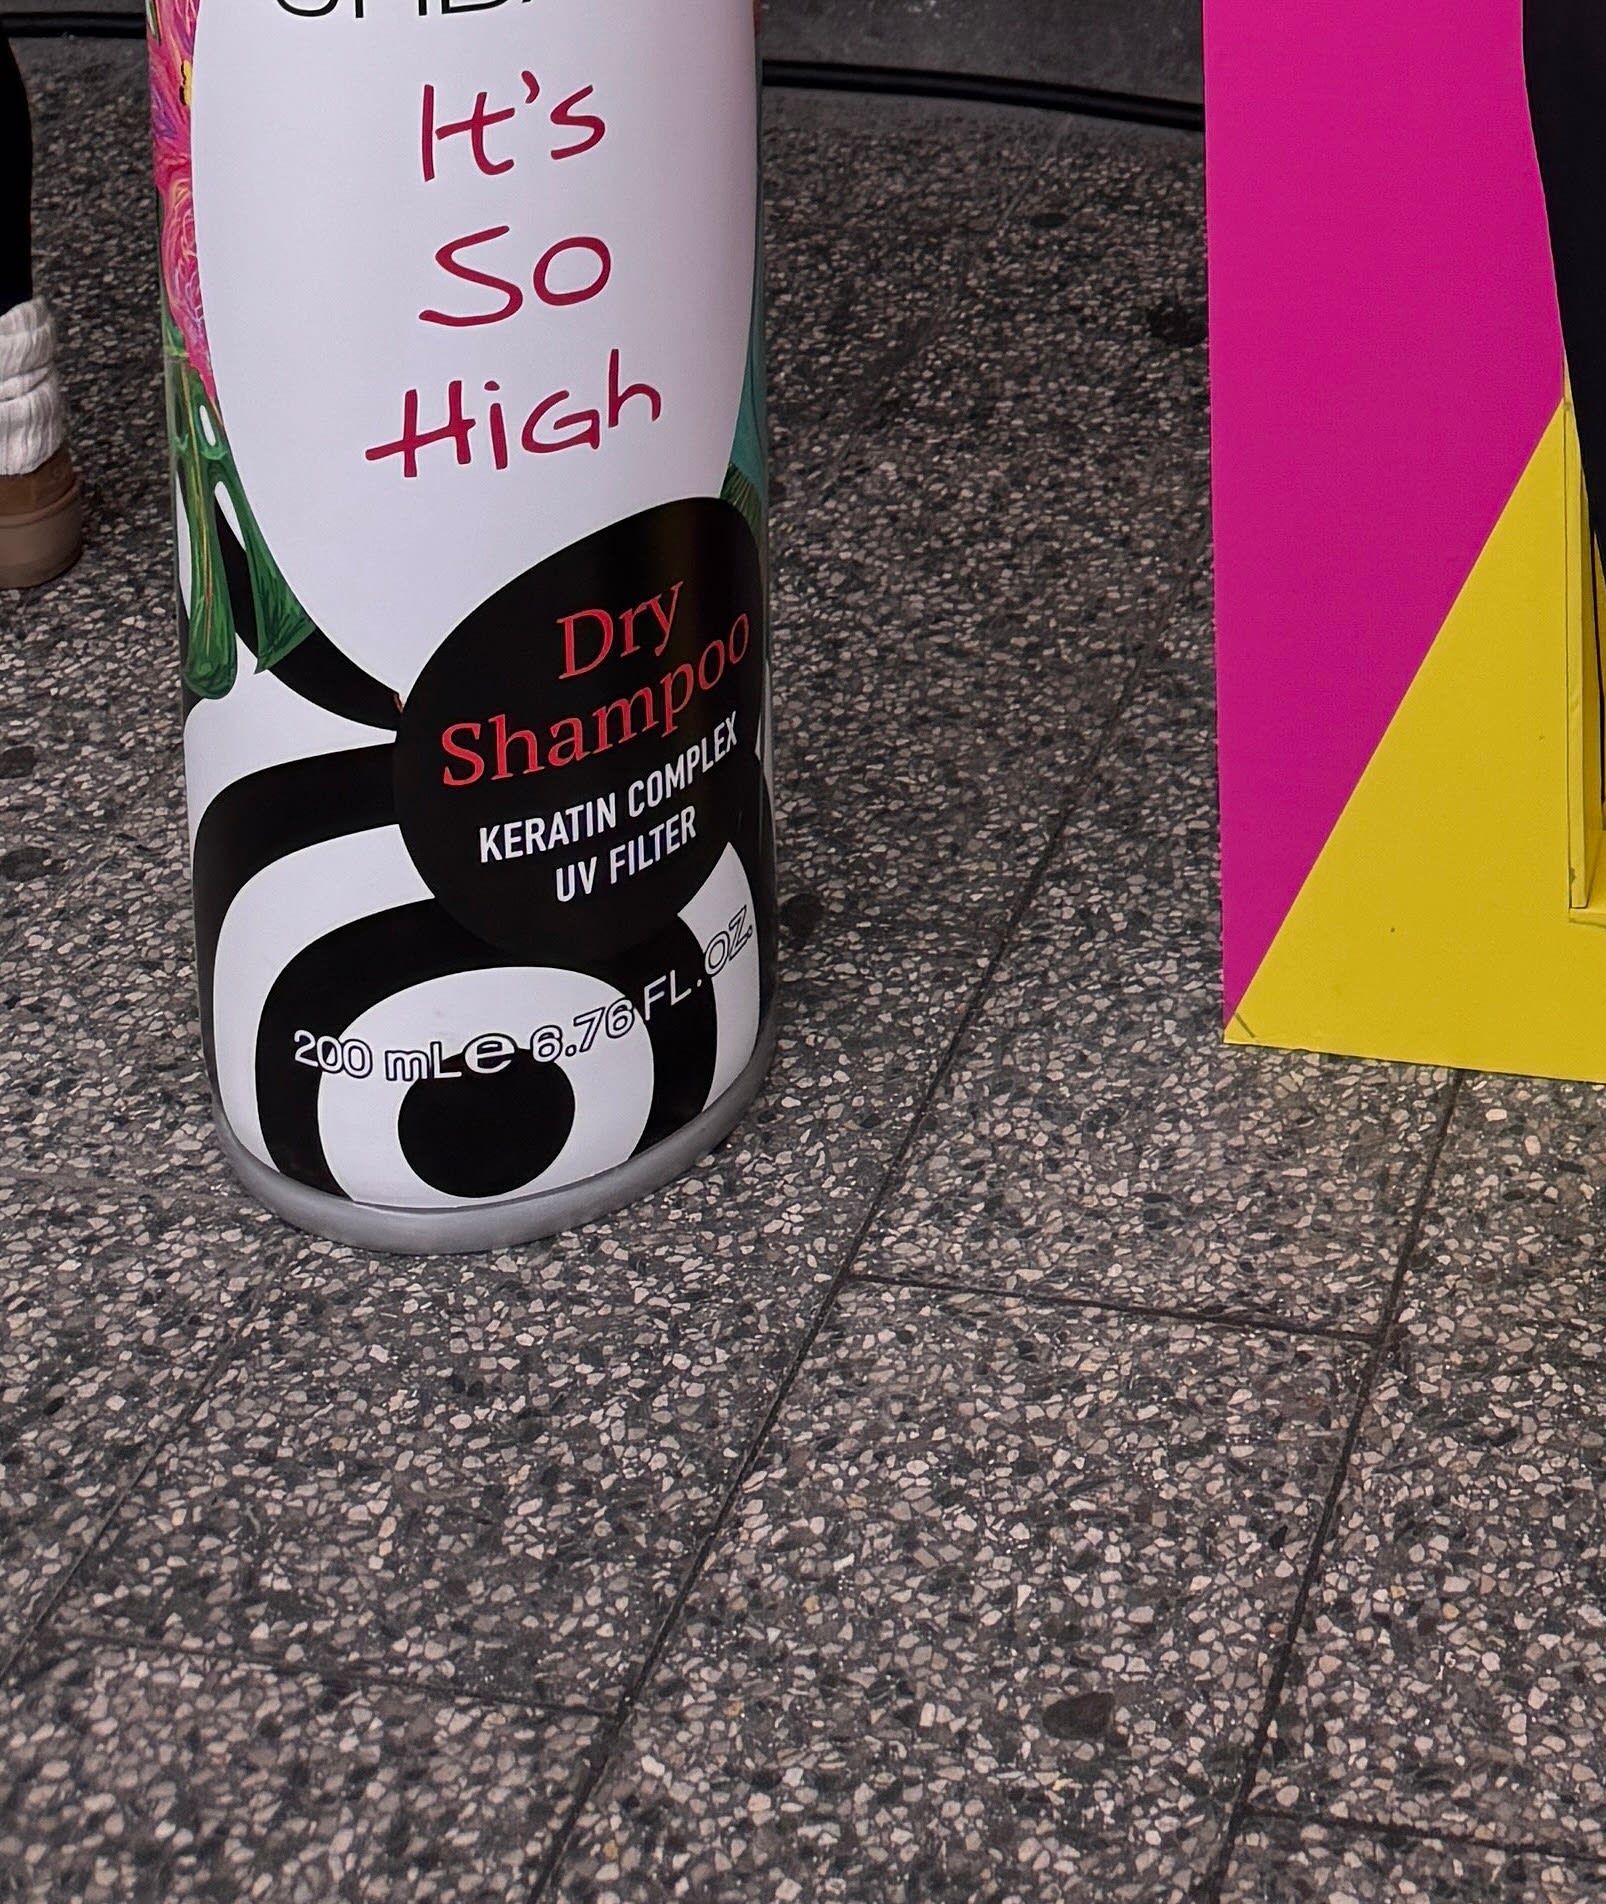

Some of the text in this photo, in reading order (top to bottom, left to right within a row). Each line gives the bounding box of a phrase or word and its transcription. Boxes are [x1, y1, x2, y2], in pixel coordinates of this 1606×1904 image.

[421, 70, 607, 183] It's
[556, 581, 684, 680] Dry
[441, 612, 750, 786] Shampoo
[479, 710, 737, 863] KERATIN COMPLEX
[555, 805, 696, 903] UV FILTER
[294, 1028, 373, 1080] 200
[530, 997, 635, 1064] 6.76
